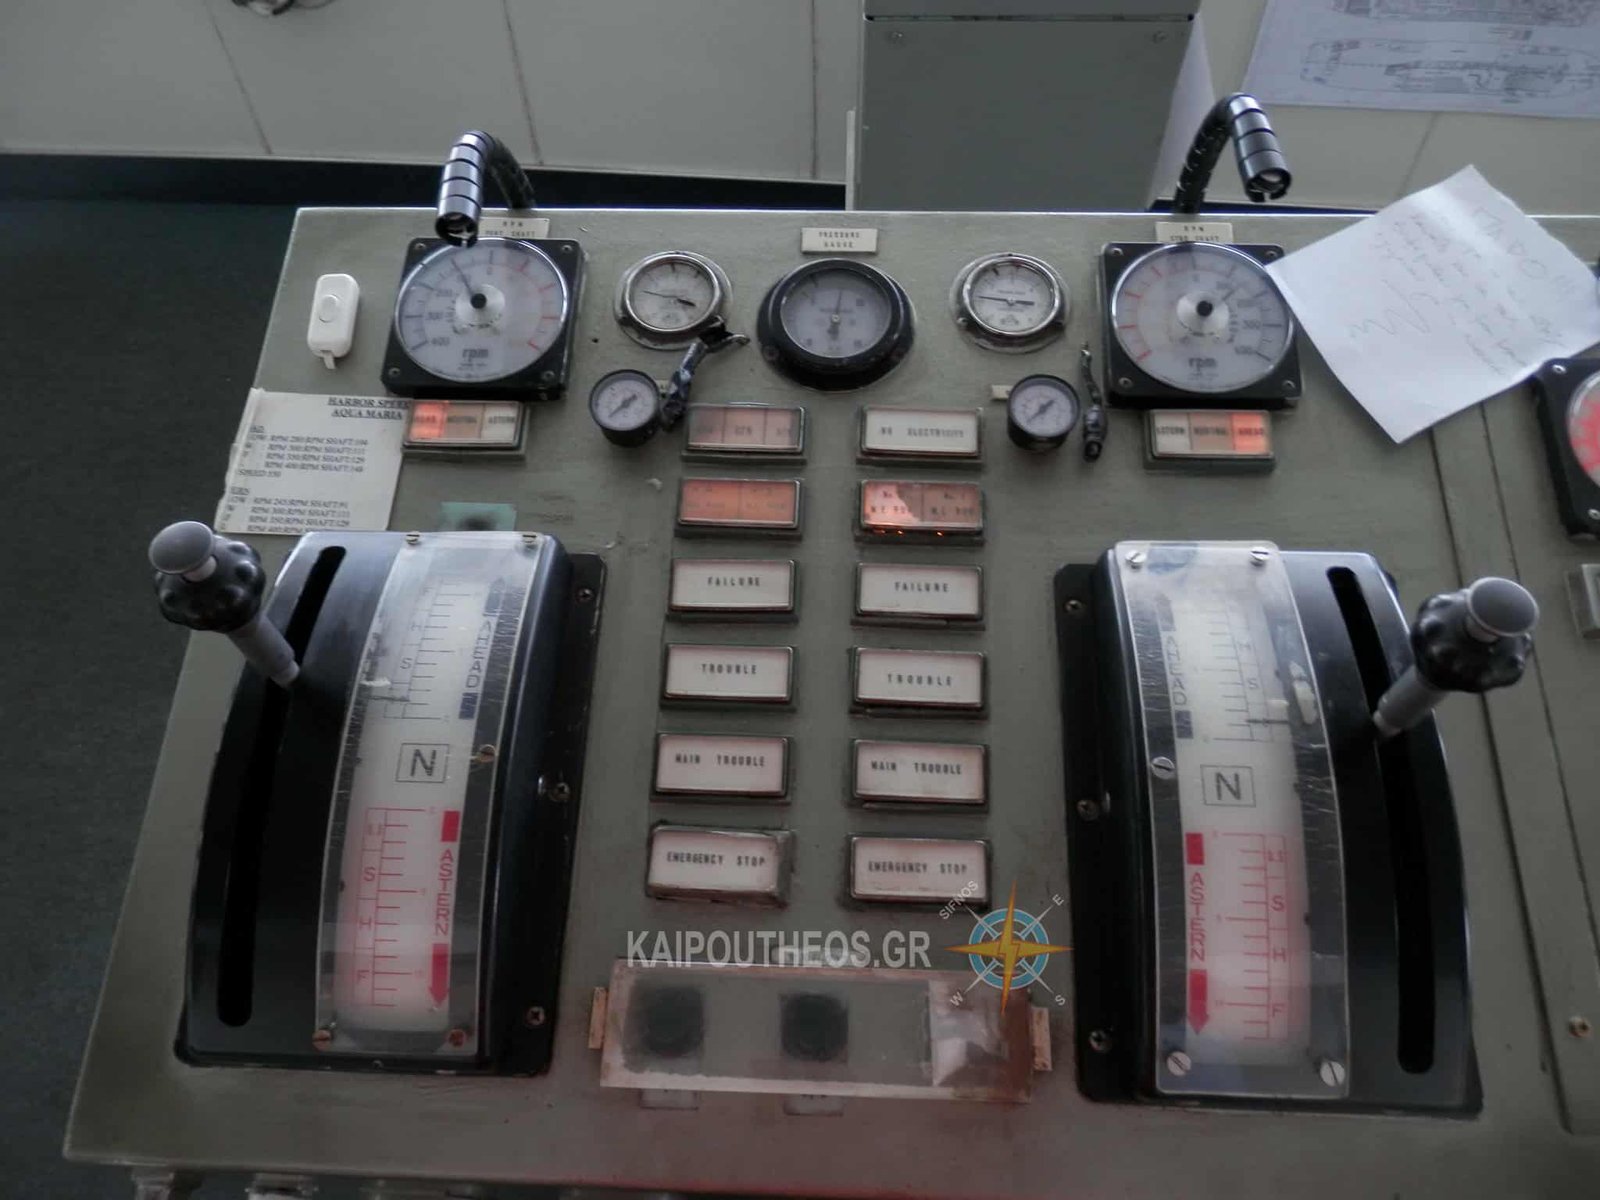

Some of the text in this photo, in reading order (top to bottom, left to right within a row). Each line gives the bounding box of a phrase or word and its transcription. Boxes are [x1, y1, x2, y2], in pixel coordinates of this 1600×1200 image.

[331, 408, 403, 420] AQUA MARIA
[707, 577, 761, 588] FAILURE
[895, 581, 950, 593] FAILURE
[466, 620, 492, 689] AHEAD
[400, 657, 413, 670] S
[701, 663, 758, 675] TROUBLE
[1165, 635, 1188, 706] AHEAD
[887, 673, 953, 686] TROUBLE
[410, 749, 437, 777] N
[674, 753, 766, 768] MAIN TROUBLE
[870, 760, 962, 776] MAIN TROUBLE
[1214, 772, 1242, 800] N
[666, 851, 766, 867] EMERGENCY STOP
[363, 866, 377, 882] S
[868, 860, 968, 875] EMERGENCY STOP
[434, 848, 455, 936] ASTERN
[1270, 895, 1285, 911] S
[1189, 871, 1206, 962] ASTERN
[1272, 949, 1287, 963] H
